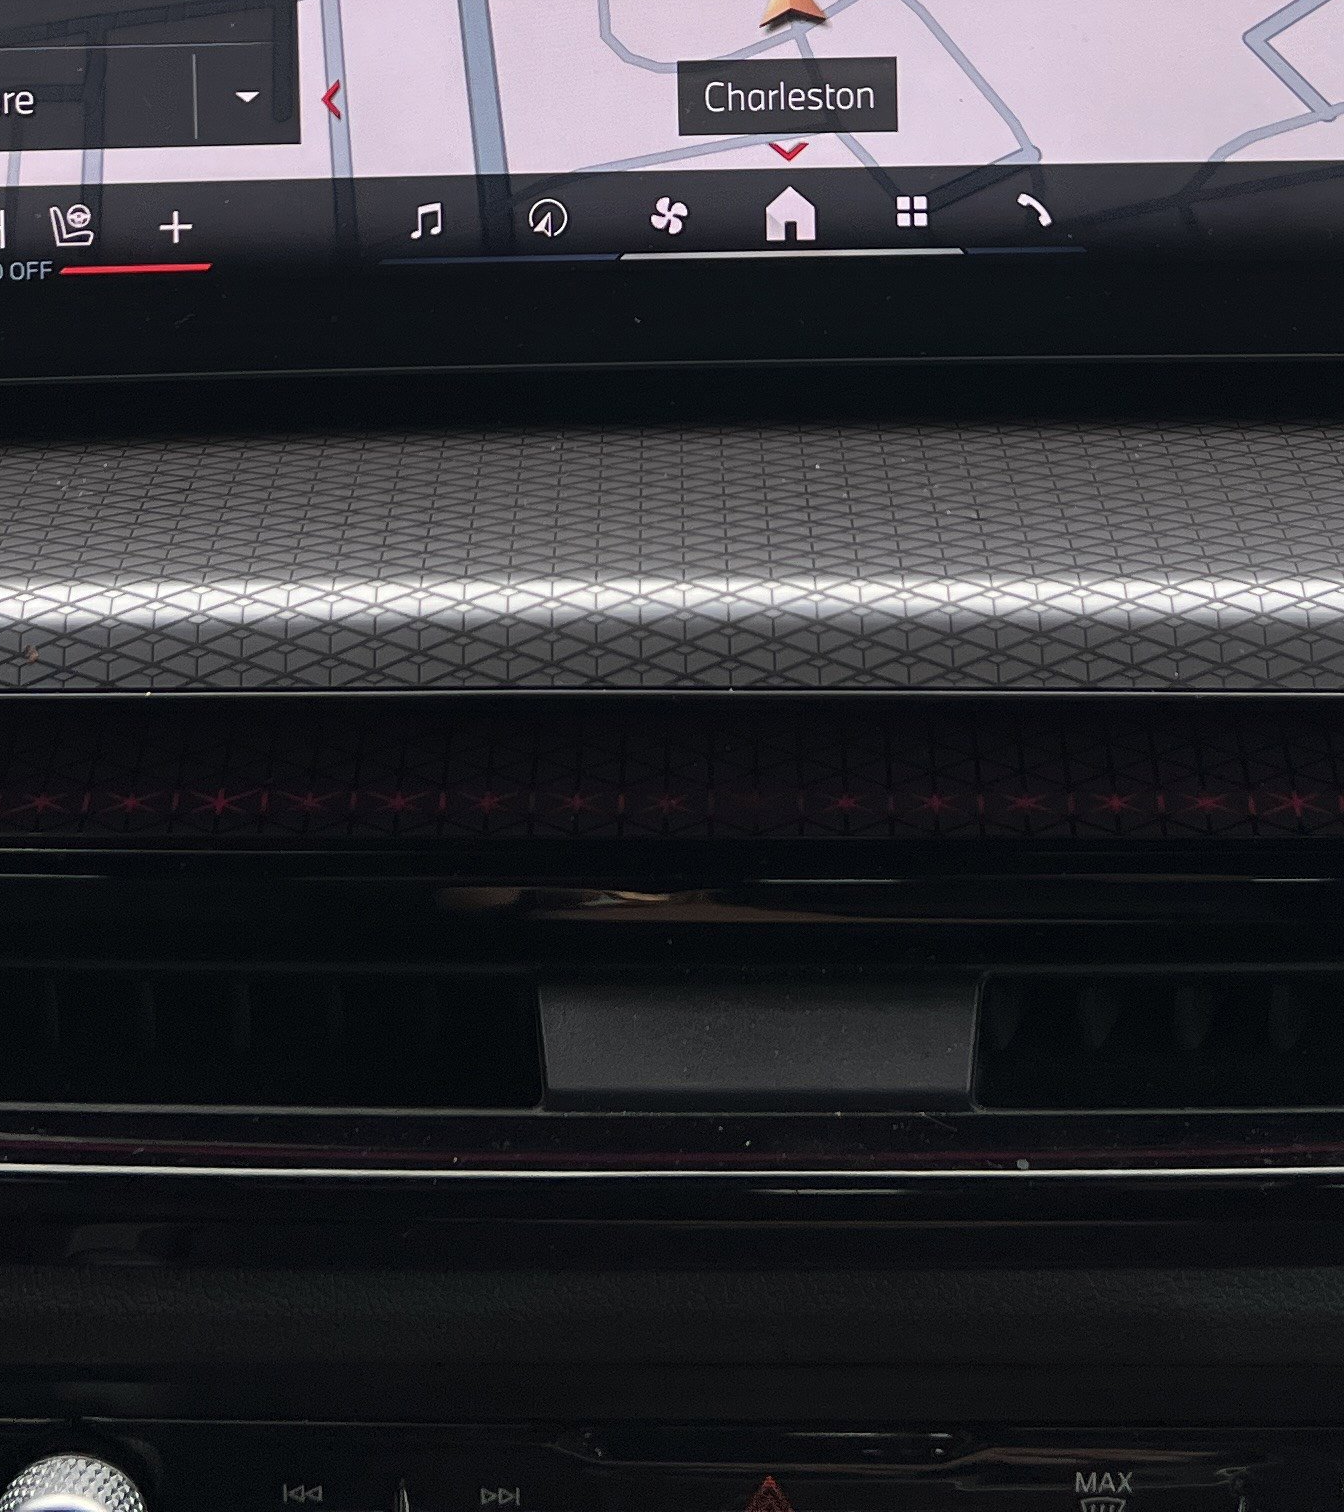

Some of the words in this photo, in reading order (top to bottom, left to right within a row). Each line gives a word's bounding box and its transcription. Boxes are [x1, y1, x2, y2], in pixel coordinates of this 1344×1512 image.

[705, 81, 875, 112] Charleston
[10, 260, 53, 281] OFF
[1075, 1471, 1134, 1493] MAX
